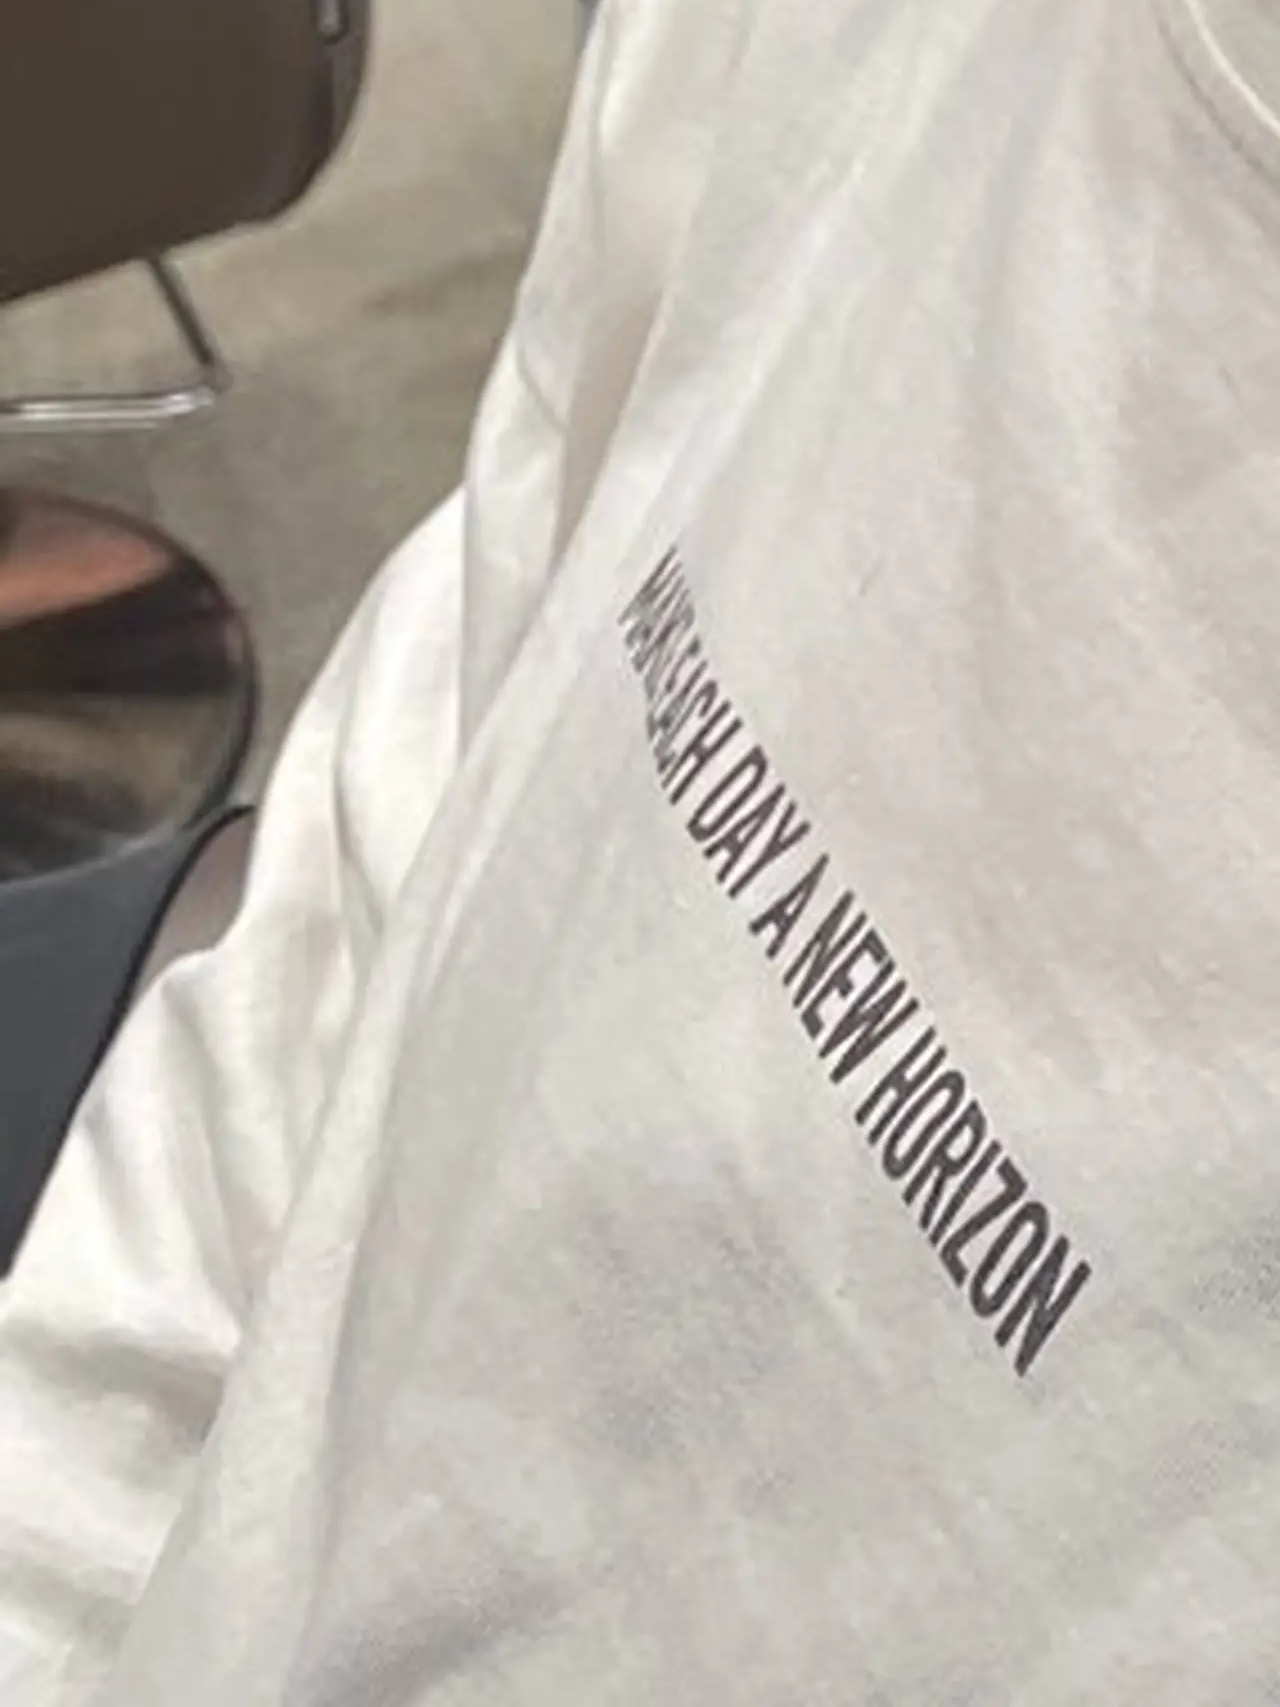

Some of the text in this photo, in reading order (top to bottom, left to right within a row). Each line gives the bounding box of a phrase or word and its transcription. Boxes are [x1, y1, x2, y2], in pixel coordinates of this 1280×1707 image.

[684, 744, 813, 901] DAY
[747, 852, 831, 962] A
[781, 889, 921, 1086] NEW
[853, 1025, 1093, 1379] HORIZON
